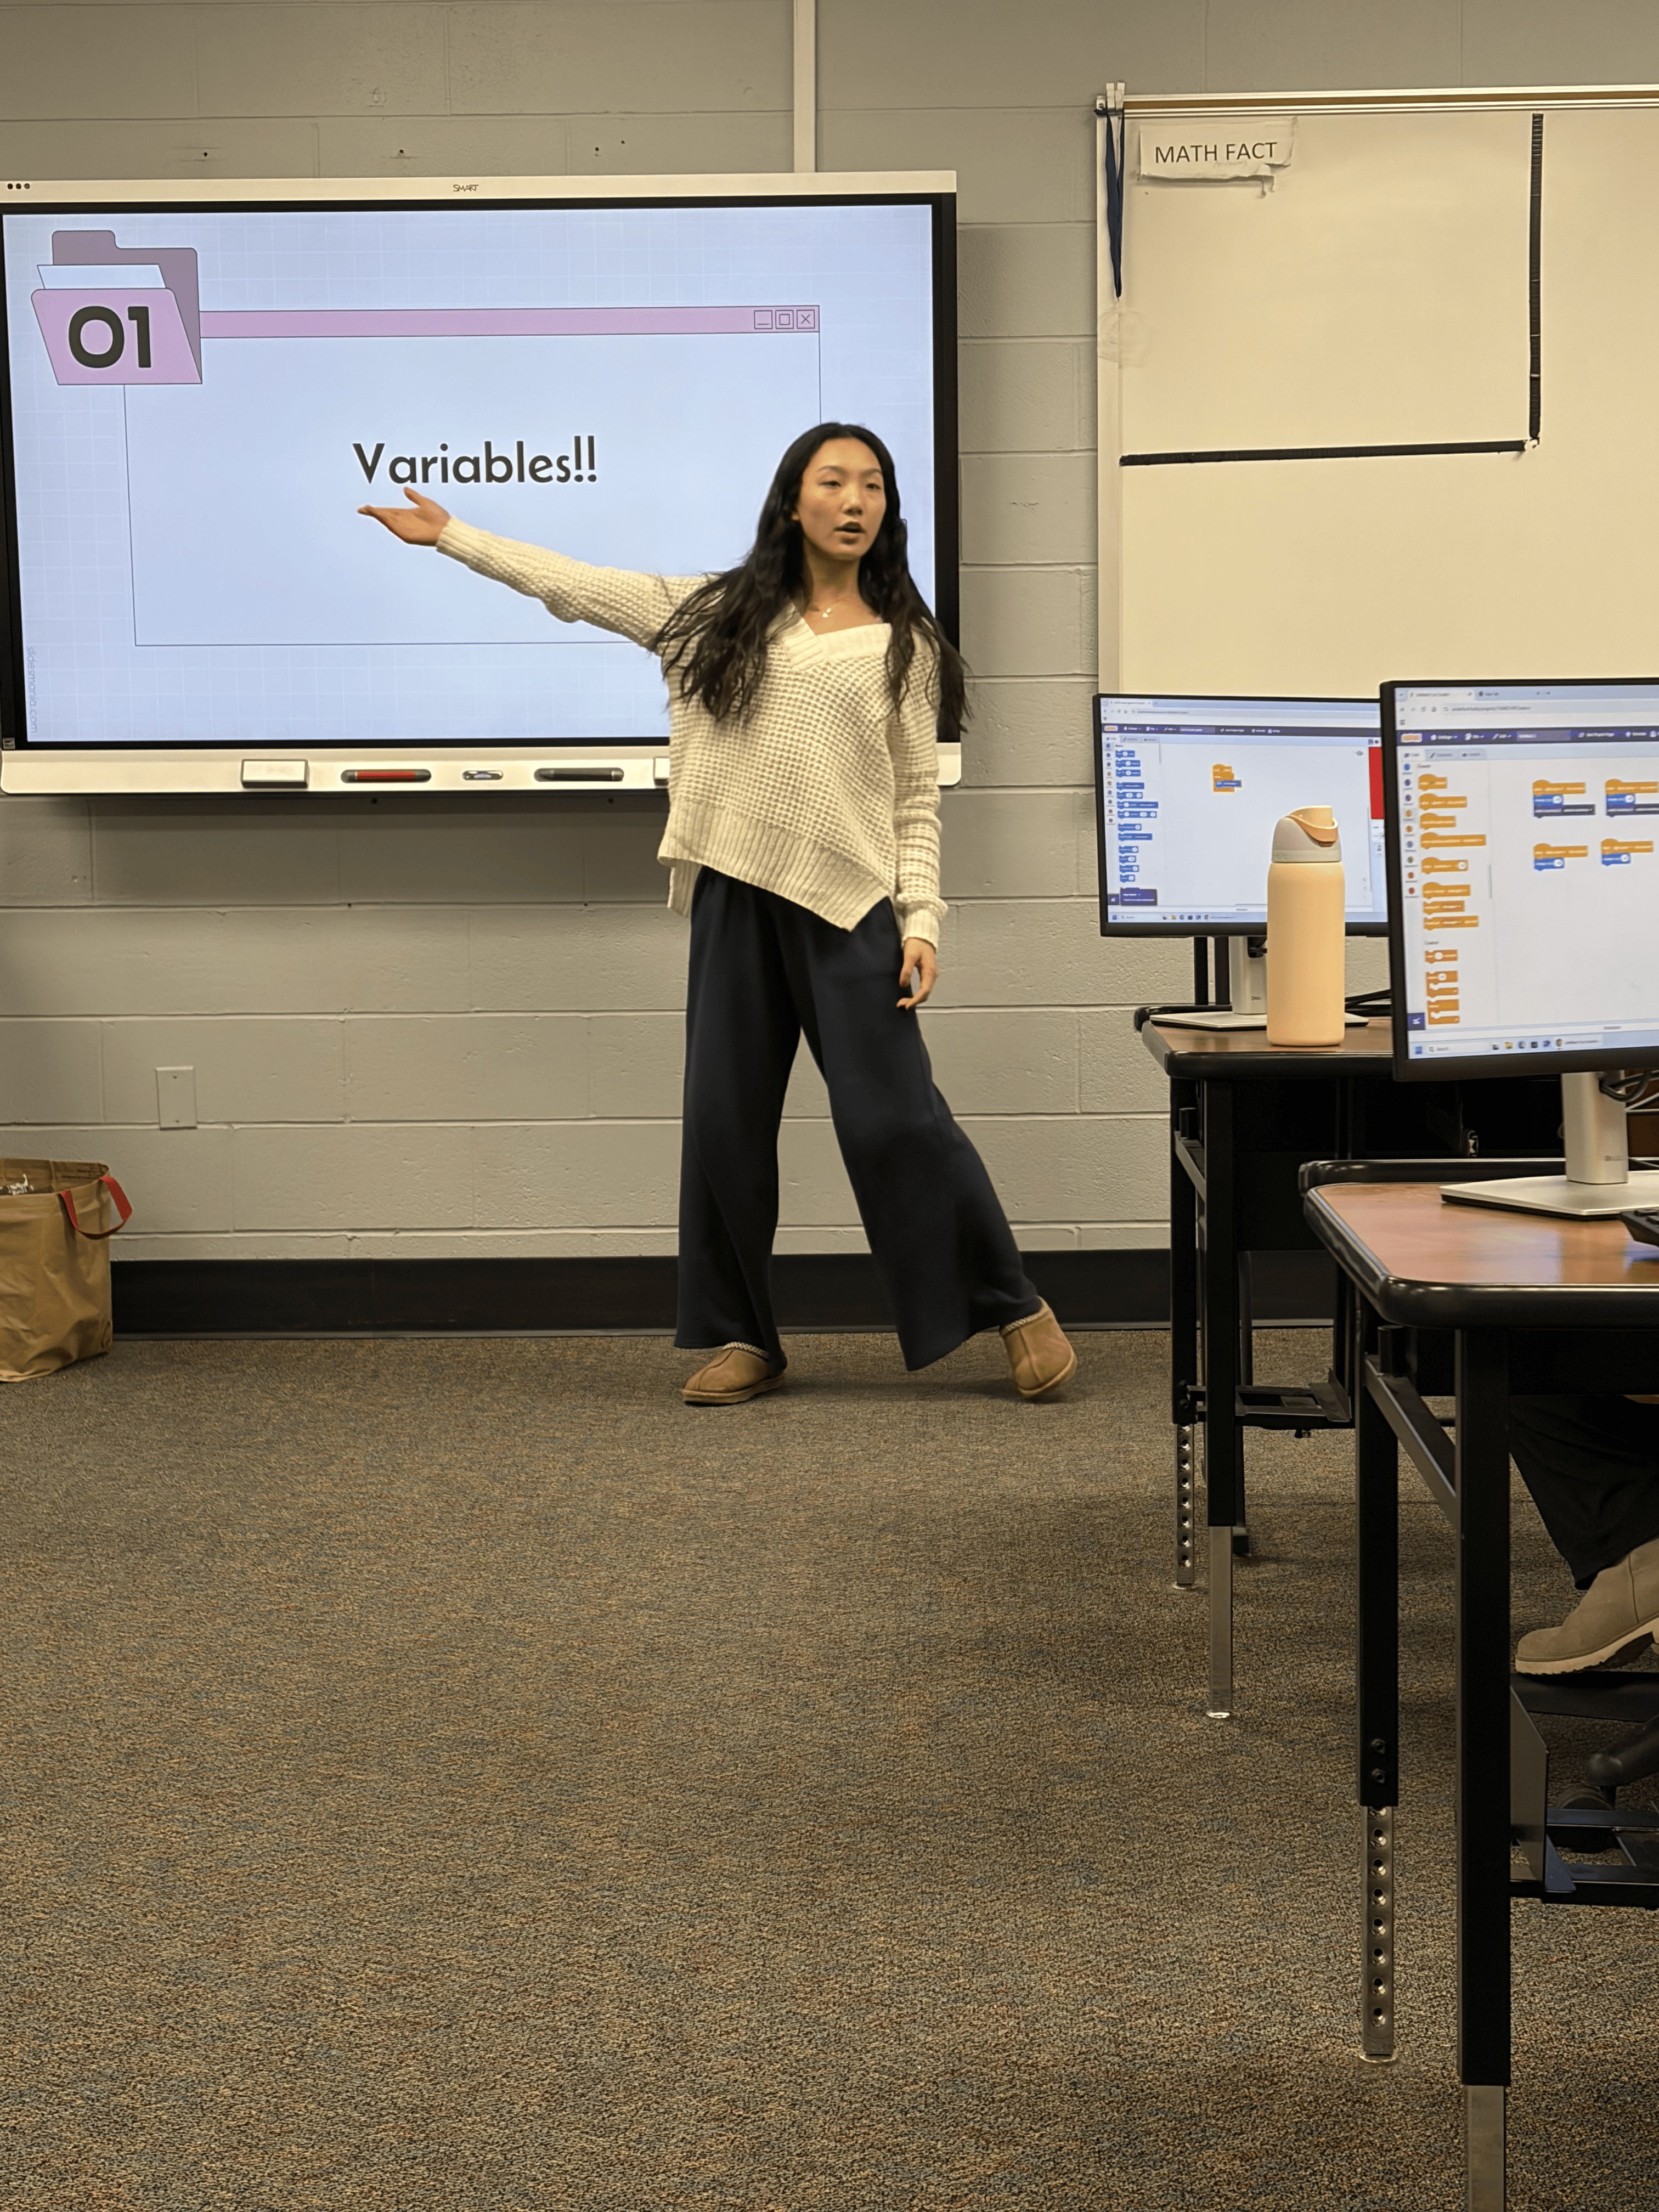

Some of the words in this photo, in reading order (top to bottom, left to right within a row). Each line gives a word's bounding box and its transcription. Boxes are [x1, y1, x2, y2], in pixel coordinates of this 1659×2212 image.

[1155, 145, 1217, 163] MATH
[1226, 142, 1277, 161] FACT
[68, 306, 151, 369] 01
[353, 436, 596, 484] Variables!!
[27, 646, 38, 733] slidesmania.com
